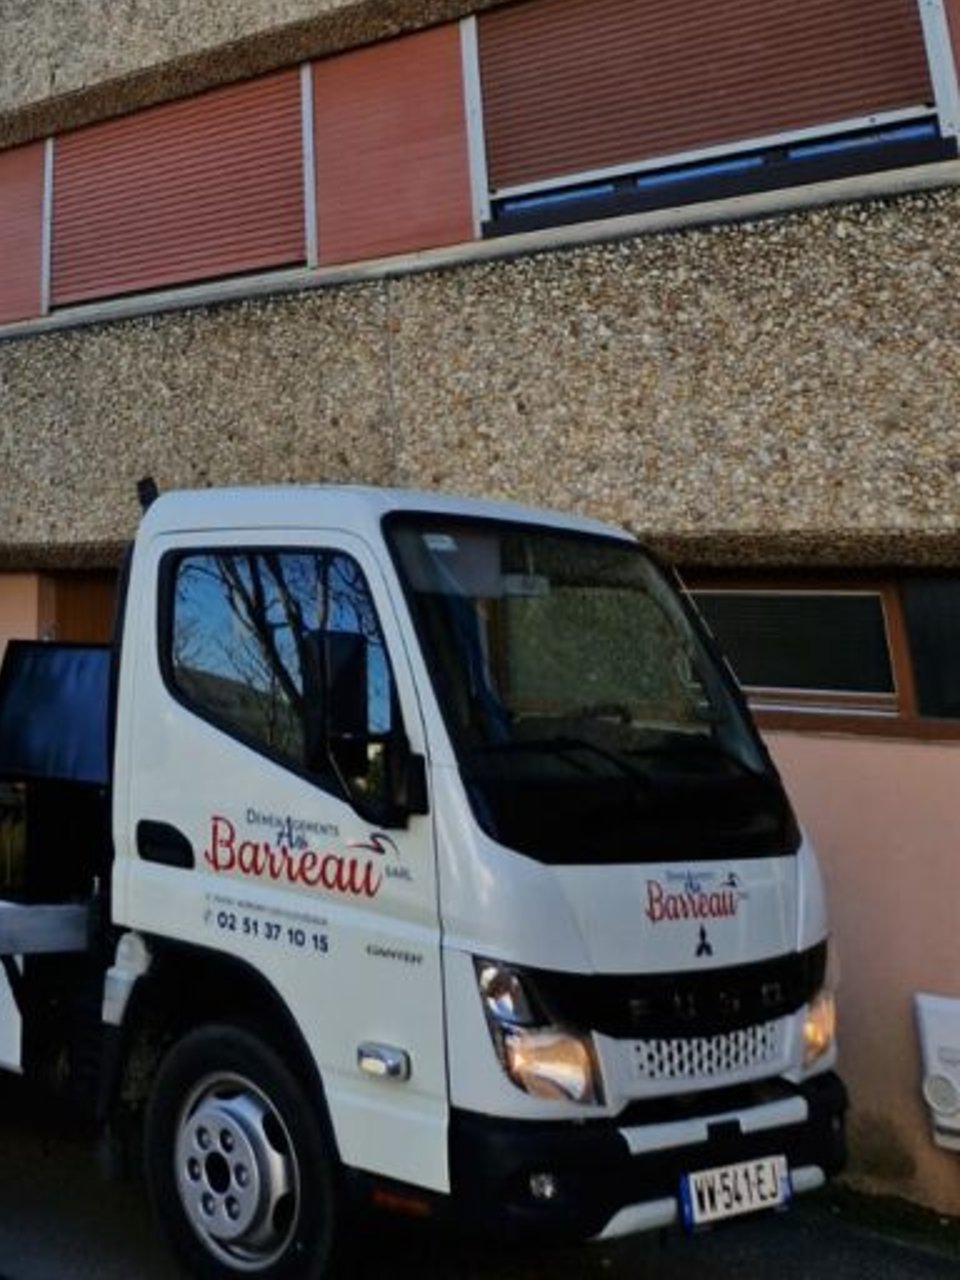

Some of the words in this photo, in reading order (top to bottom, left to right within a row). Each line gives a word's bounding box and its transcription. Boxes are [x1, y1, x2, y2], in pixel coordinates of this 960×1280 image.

[204, 816, 383, 898] Barreau
[645, 879, 738, 924] Barreau
[217, 911, 237, 932] 02
[242, 917, 259, 937] 51
[264, 921, 282, 941] 37
[288, 927, 306, 947] 10
[311, 933, 329, 953] 15
